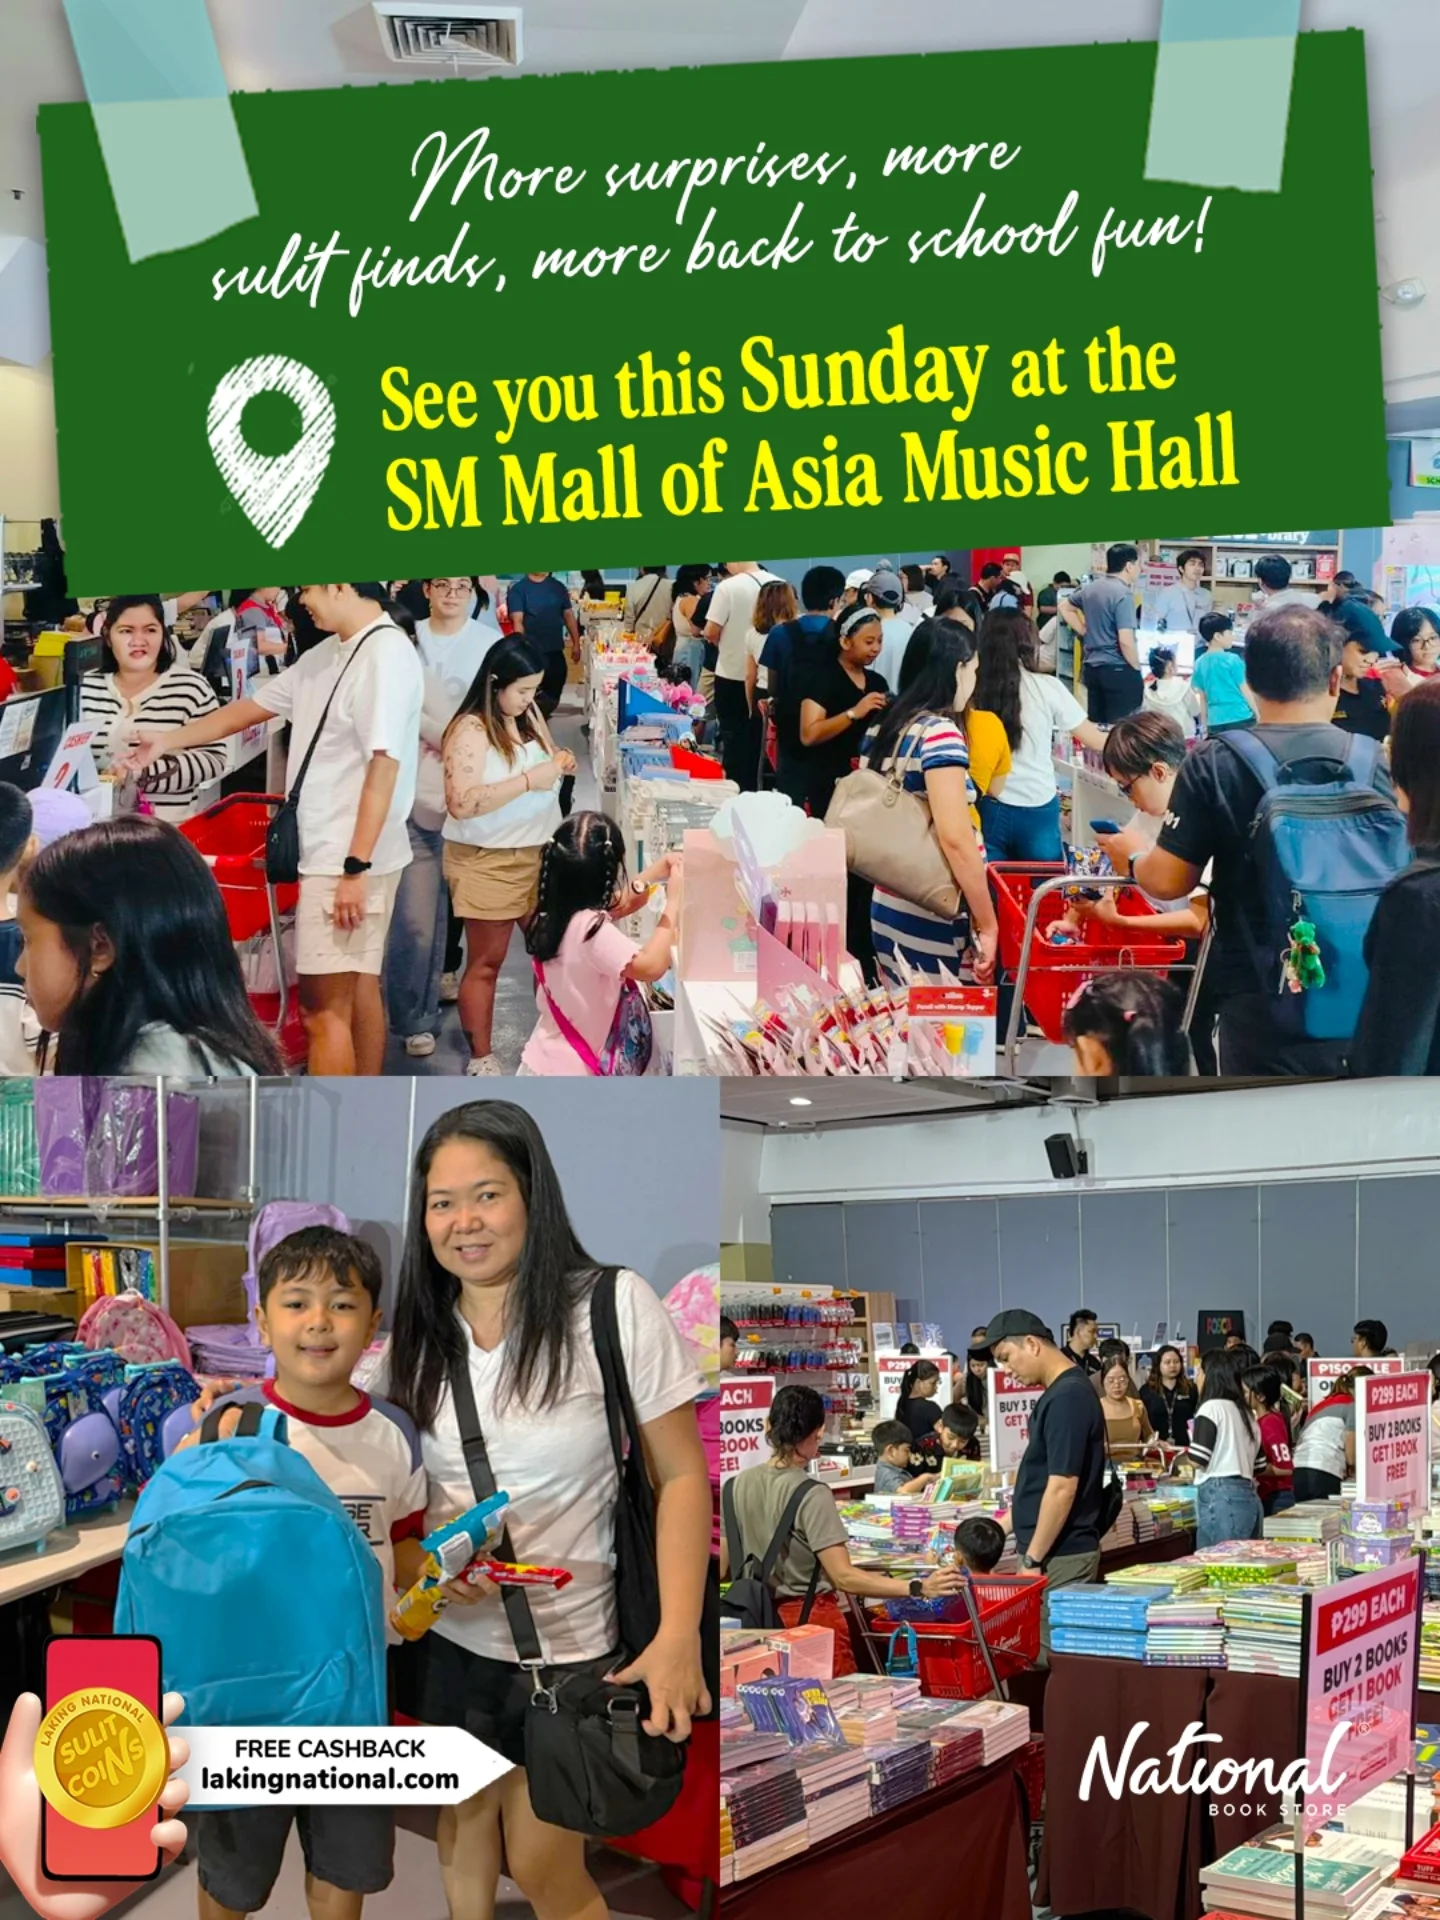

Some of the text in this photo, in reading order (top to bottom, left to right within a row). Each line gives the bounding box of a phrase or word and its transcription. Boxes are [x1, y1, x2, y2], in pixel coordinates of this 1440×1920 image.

[1395, 1382, 1418, 1403] EACH
[1000, 1401, 1019, 1413] BUY
[1021, 1400, 1028, 1411] 3
[1004, 1414, 1022, 1427] GET
[1369, 1416, 1422, 1442] BUY 2 BOOKS
[1272, 1443, 1291, 1462] 18
[1372, 1444, 1389, 1464] GET
[1396, 1437, 1418, 1458] BOOK
[1387, 1460, 1407, 1482] FREE!
[1371, 1585, 1406, 1622] EACH
[1323, 1631, 1408, 1693] BUY 2 BOOKS
[1328, 1688, 1354, 1721] GET
[1366, 1662, 1403, 1701] BOOK
